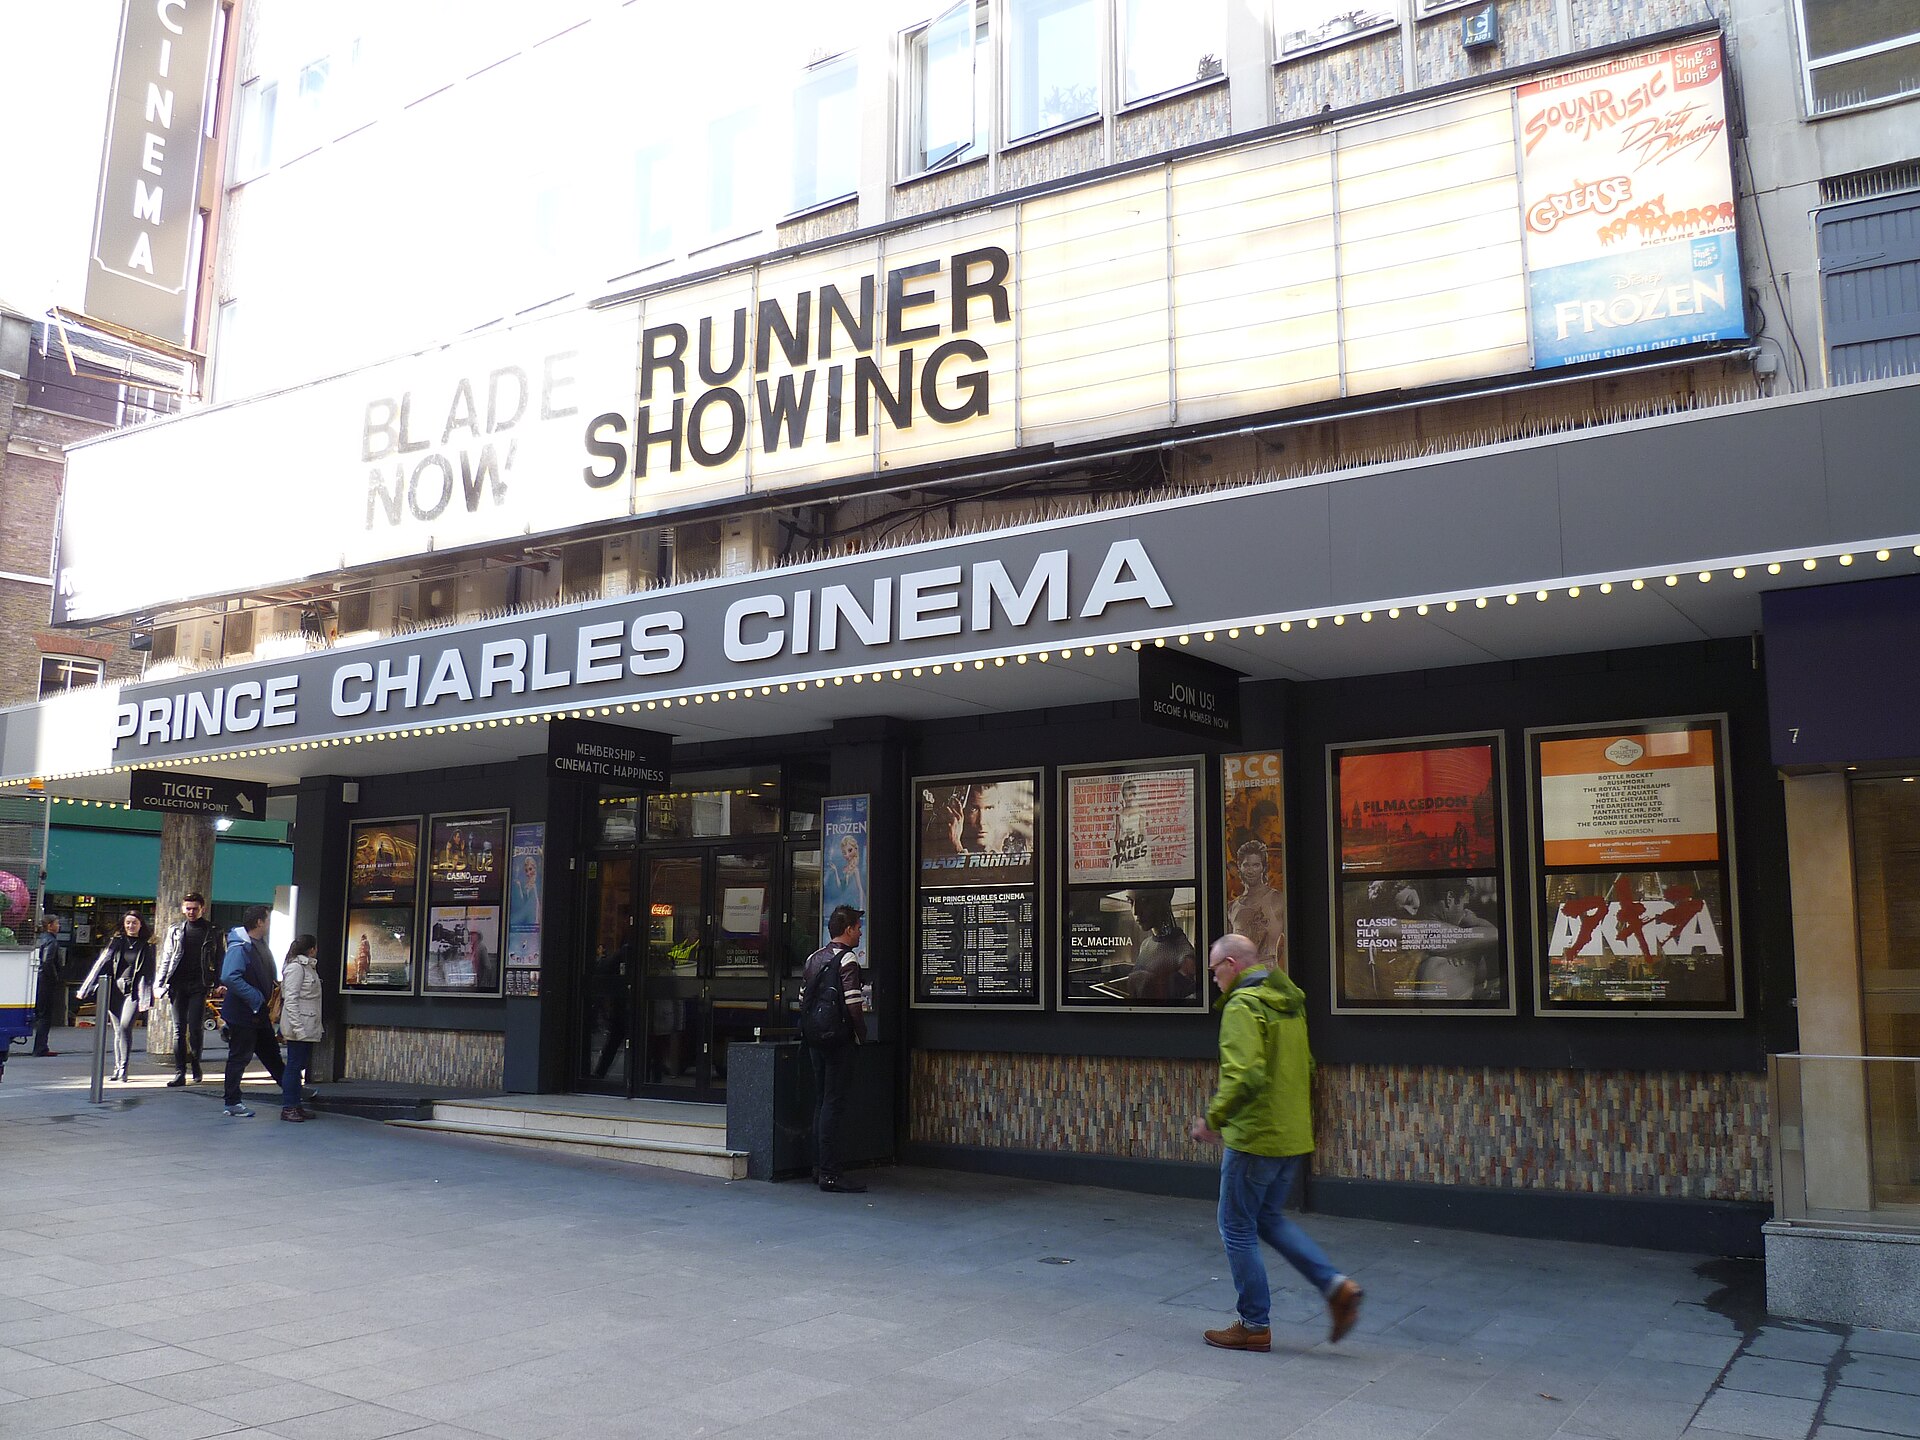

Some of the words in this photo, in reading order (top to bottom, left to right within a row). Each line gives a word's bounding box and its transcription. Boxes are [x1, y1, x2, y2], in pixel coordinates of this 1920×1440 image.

[1539, 78, 1558, 91] THE
[1561, 64, 1610, 86] LONDON
[1611, 57, 1645, 76] HOME
[1647, 52, 1662, 64] OF
[1525, 89, 1613, 157] SOUND
[1565, 117, 1585, 134] OF
[1617, 101, 1711, 154] Dirty
[128, 0, 186, 275] CINEMA
[1634, 115, 1725, 173] Dancing
[1526, 175, 1632, 233] GREASE
[1597, 193, 1666, 246] ROCKY
[1635, 201, 1735, 237] HORROR
[1640, 232, 1695, 246] PICTURE
[1699, 224, 1736, 236] SHOW
[1554, 273, 1726, 341] FROZEN
[362, 349, 579, 463] BLADE
[640, 246, 1011, 399] RUNNER
[365, 438, 517, 530] NOW
[583, 339, 989, 488] SHOWING
[113, 675, 297, 749] PRINCE
[331, 611, 684, 717] CHARLES
[724, 539, 1172, 664] CINEMA
[1169, 682, 1195, 706] JOIN
[1200, 691, 1215, 711] US!
[1153, 700, 1181, 718] BECOME
[1183, 709, 1187, 719] A
[1189, 710, 1211, 726] MEMBER
[1213, 717, 1229, 729] NOW
[1788, 728, 1800, 744] 7
[577, 742, 636, 763] MEMBERSHIP
[639, 755, 647, 763] =
[555, 757, 610, 776] CINEMATIC
[613, 765, 664, 782] HAPPINESS
[1226, 755, 1278, 779] PCC
[162, 782, 213, 800] TICKET
[1225, 778, 1280, 789] MEMBERSHIP
[1622, 783, 1671, 791] TENENBAUMS
[1620, 795, 1658, 803] CHEVALIER
[1627, 789, 1658, 797] AQUATIC
[143, 796, 200, 811] COLLECTION
[202, 802, 228, 813] POINT
[1363, 796, 1467, 813] FILMAGEDDON
[1606, 801, 1648, 809] DARJEELING
[826, 821, 867, 836] FROZEN
[1619, 818, 1655, 826] BUDAPEST
[1114, 834, 1144, 853] WILD
[922, 855, 966, 870] BLADE
[969, 853, 1031, 868] RUNNER
[1112, 845, 1147, 868] TALES
[447, 872, 470, 881] CASINO
[469, 875, 487, 884] HEAT
[928, 896, 942, 904] THE
[943, 895, 966, 903] PRINCE
[967, 894, 998, 902] CHARLES
[999, 893, 1025, 901] CINEMA
[1356, 919, 1397, 927] CLASSIC
[1072, 937, 1133, 948] EX_MACHINA
[1357, 929, 1379, 938] FILM
[1357, 939, 1397, 948] SEASON
[734, 956, 759, 964] MINUTES
